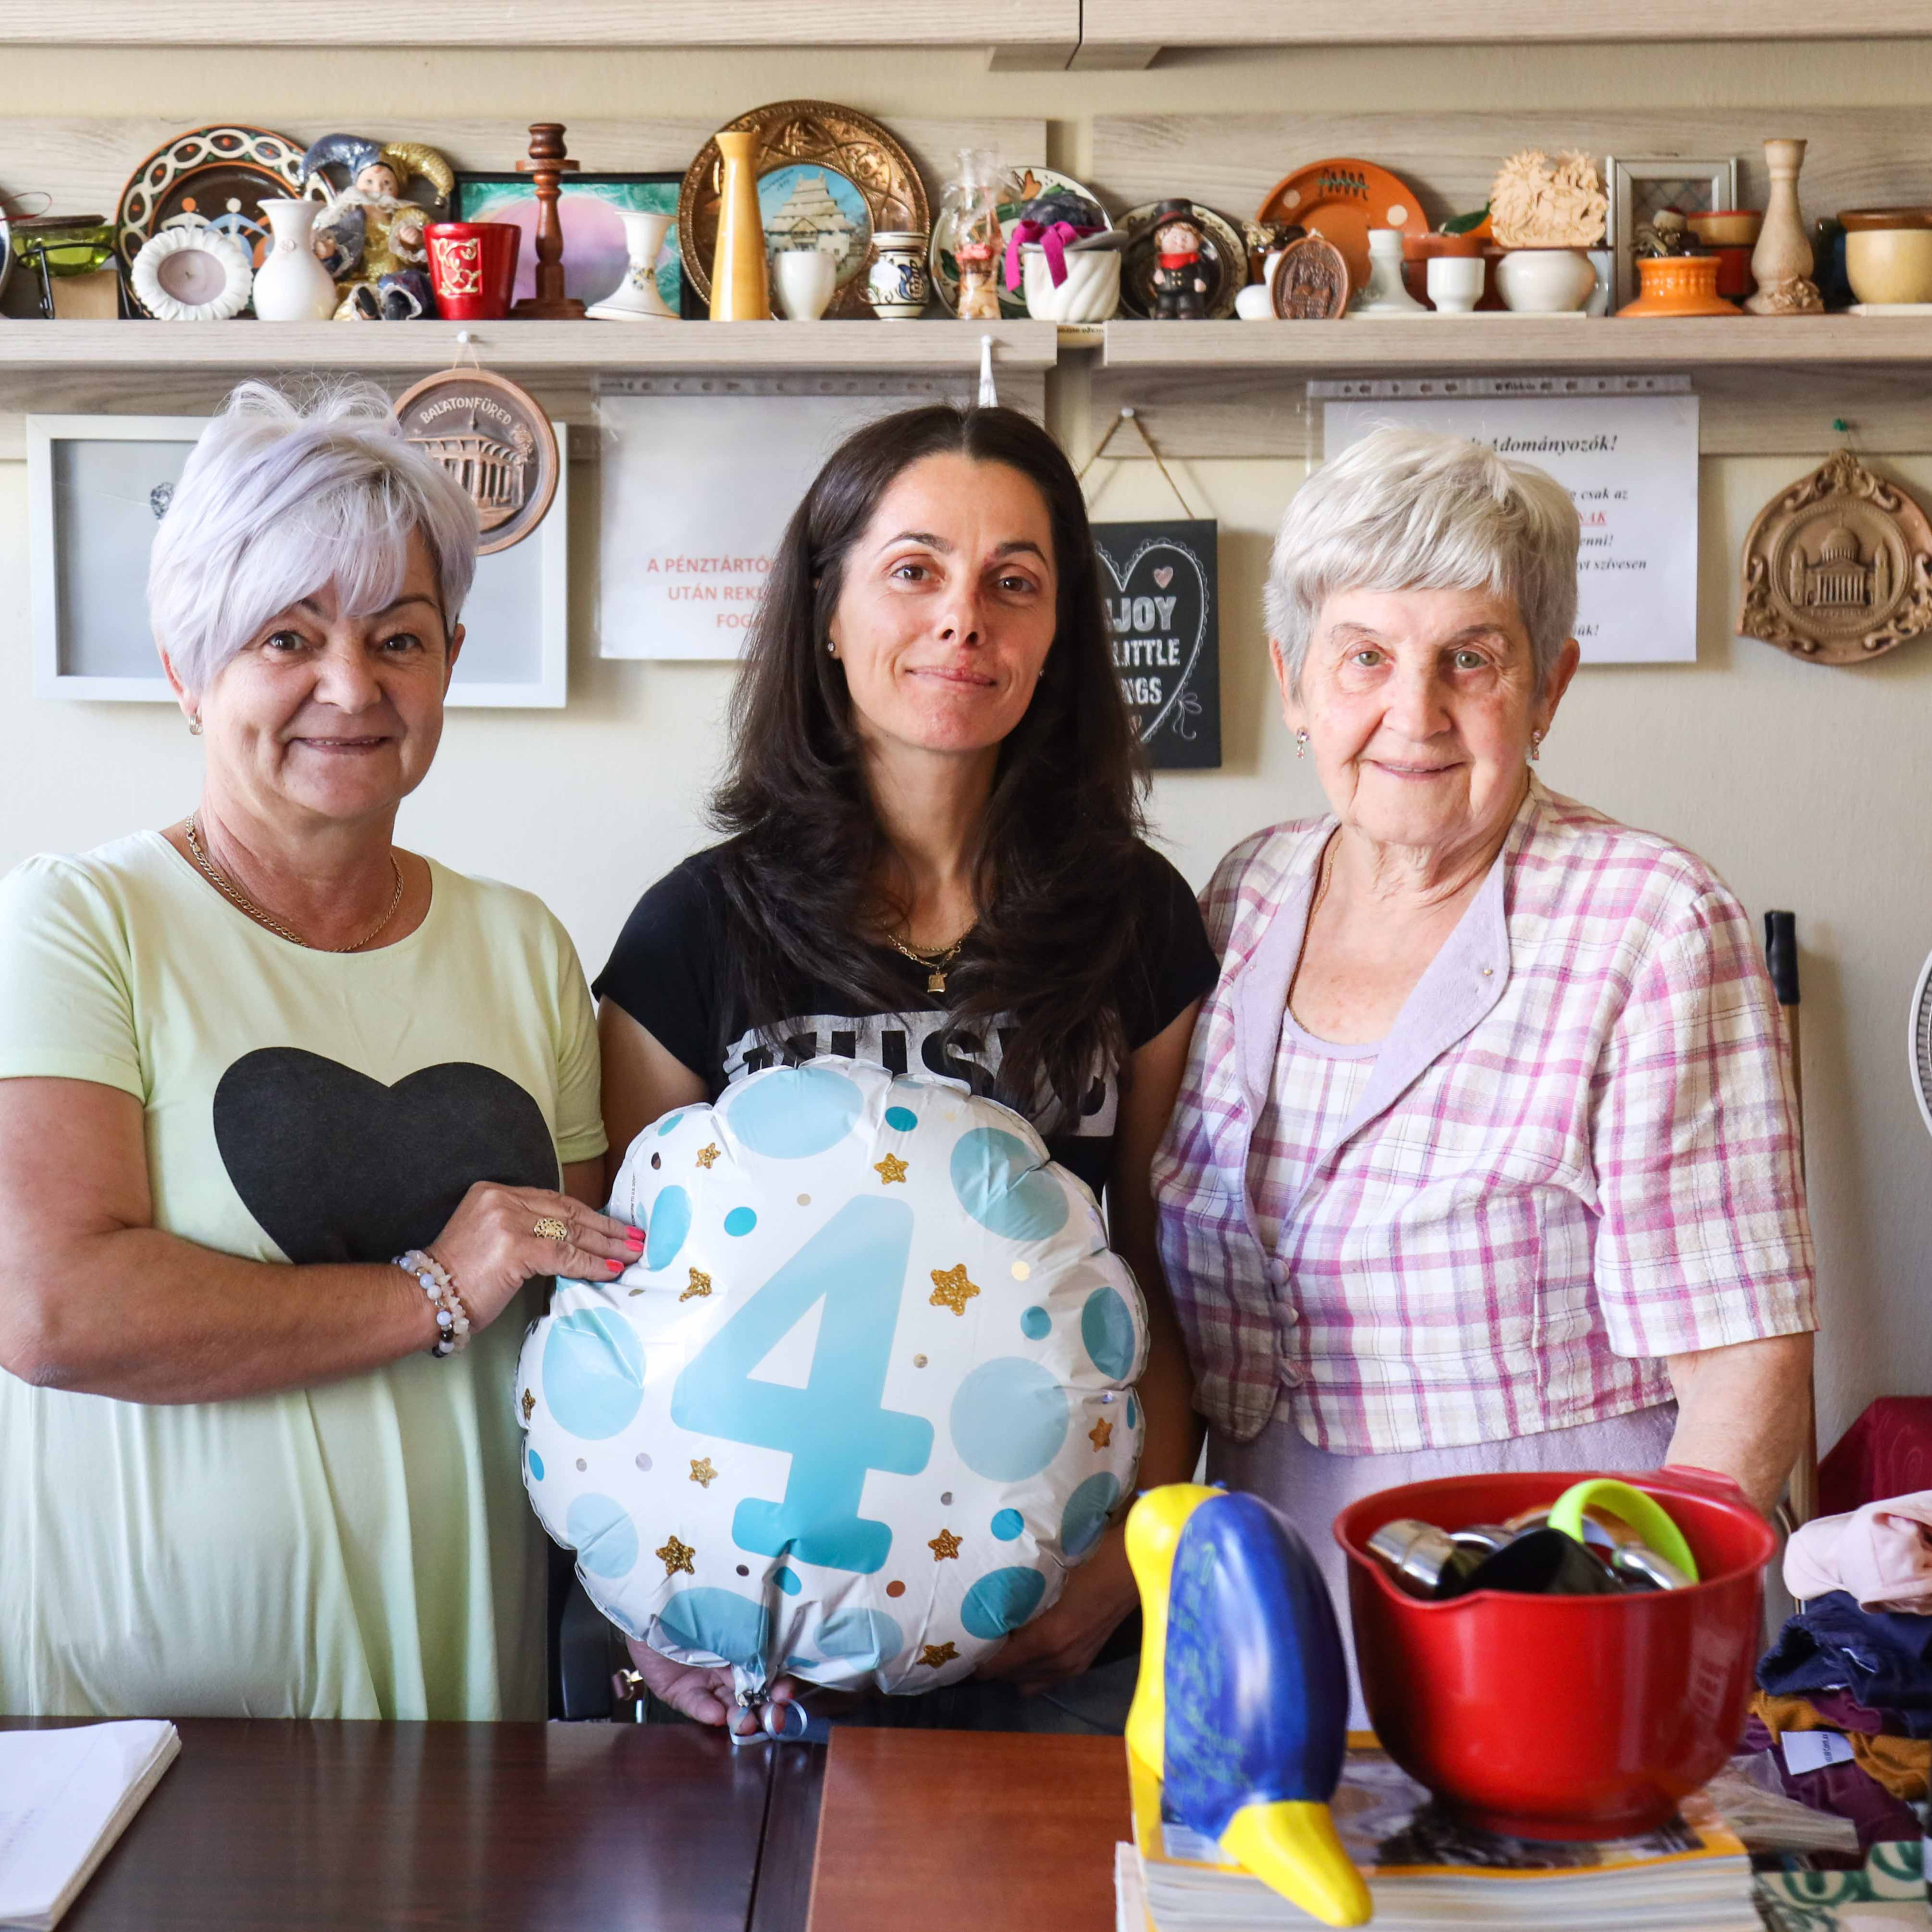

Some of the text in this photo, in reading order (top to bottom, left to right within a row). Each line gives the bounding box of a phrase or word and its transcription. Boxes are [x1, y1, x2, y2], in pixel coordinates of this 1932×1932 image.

[419, 397, 512, 425] BALATONFÜRED
[1580, 488, 1609, 500] csak
[647, 558, 659, 573] A
[668, 582, 717, 600] UTÁN
[717, 614, 755, 629] FOG
[1121, 677, 1162, 705] NGS
[670, 1194, 934, 1573] 4
